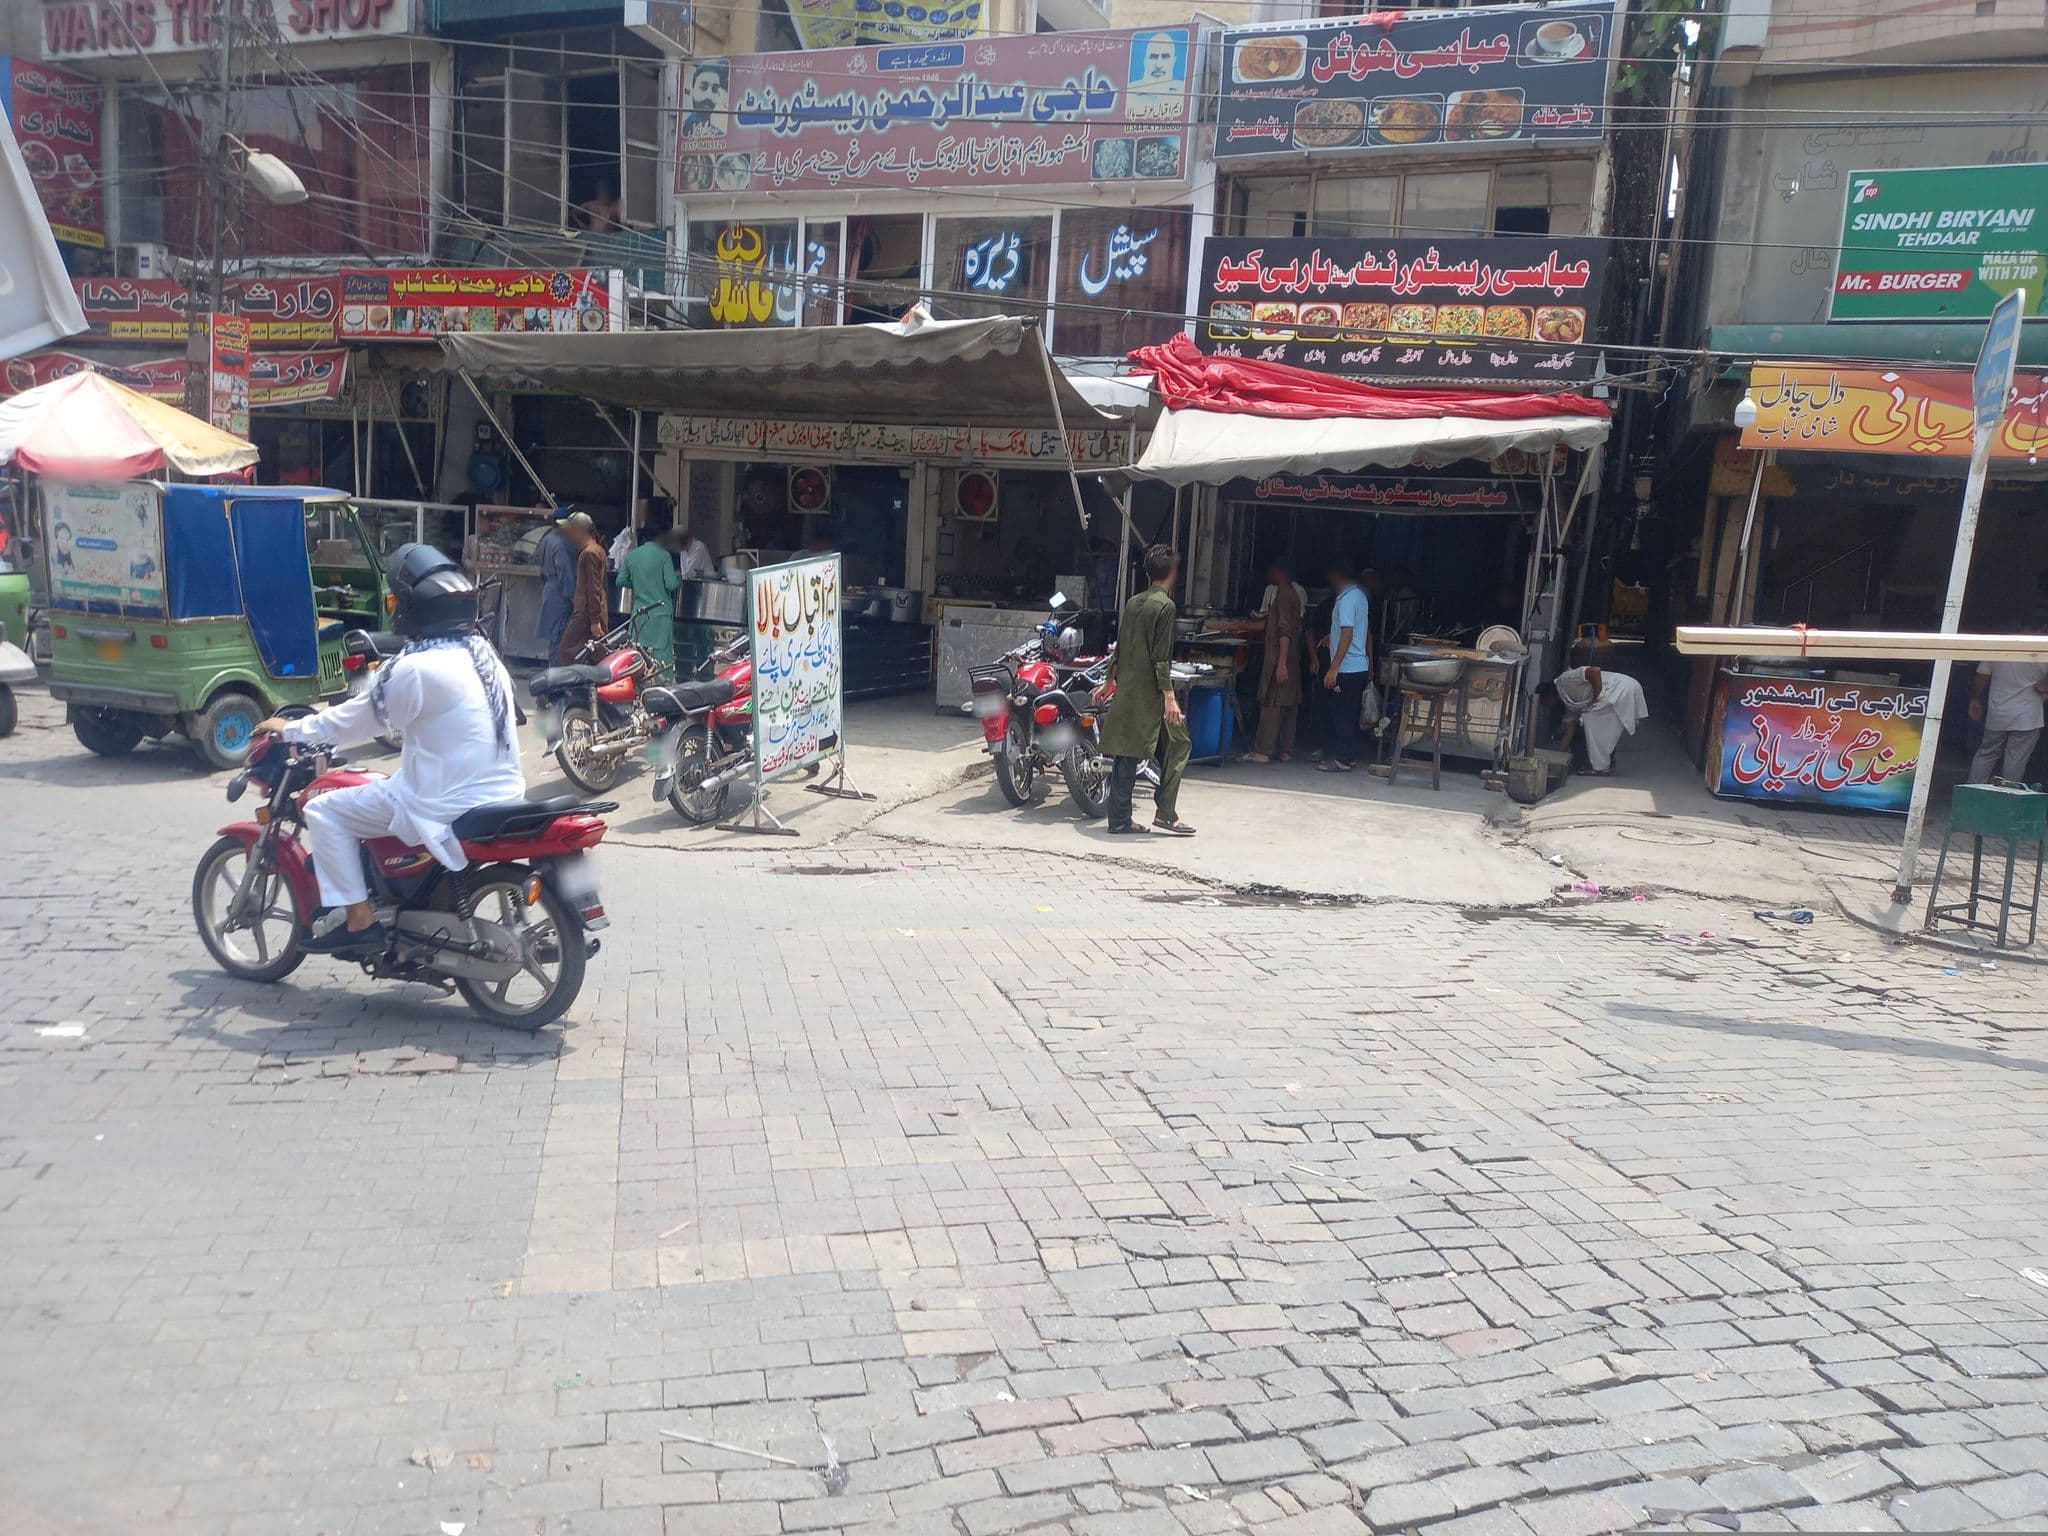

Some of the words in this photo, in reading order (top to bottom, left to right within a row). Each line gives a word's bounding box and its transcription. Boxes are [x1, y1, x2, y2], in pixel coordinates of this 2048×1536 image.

[43, 0, 156, 49] WARIS
[168, 0, 279, 44] TIKA
[289, 0, 391, 33] SHOP
[1395, 27, 1510, 78] عباسی
[736, 79, 868, 136] ریسٹورنٹ
[870, 70, 1026, 132] عبدالرحمن
[1032, 64, 1118, 121] حاجی
[1851, 210, 1935, 231] SINDHI
[1937, 207, 2036, 229] BIRYANI
[1897, 231, 1980, 247] TEHDAAR
[1081, 224, 1159, 295] سپیشل
[1213, 249, 1264, 293] کیو
[1299, 249, 1332, 295] بار
[1352, 247, 1491, 296] ریسٹورنٹ
[1492, 250, 1590, 297] عباسی
[1840, 274, 1872, 290] Mr.
[1878, 272, 1962, 290] BURGER
[1978, 266, 2013, 282] WITH
[2012, 266, 2039, 281] 7UP
[240, 282, 335, 319] وارث
[392, 272, 424, 301] شاپ
[423, 272, 459, 296] ملک
[505, 270, 546, 298] حاجی
[1761, 371, 1812, 413] چاول
[1811, 370, 1845, 410] دال
[1757, 412, 1803, 441] کباب
[1800, 415, 1840, 440] شامی
[1850, 371, 1978, 453] ریانی
[757, 577, 782, 641] بالا
[1825, 690, 1860, 713] کی
[1859, 694, 1927, 720] کراچی
[1733, 713, 1820, 793] بریانی
[1815, 727, 1920, 792] سندھی
